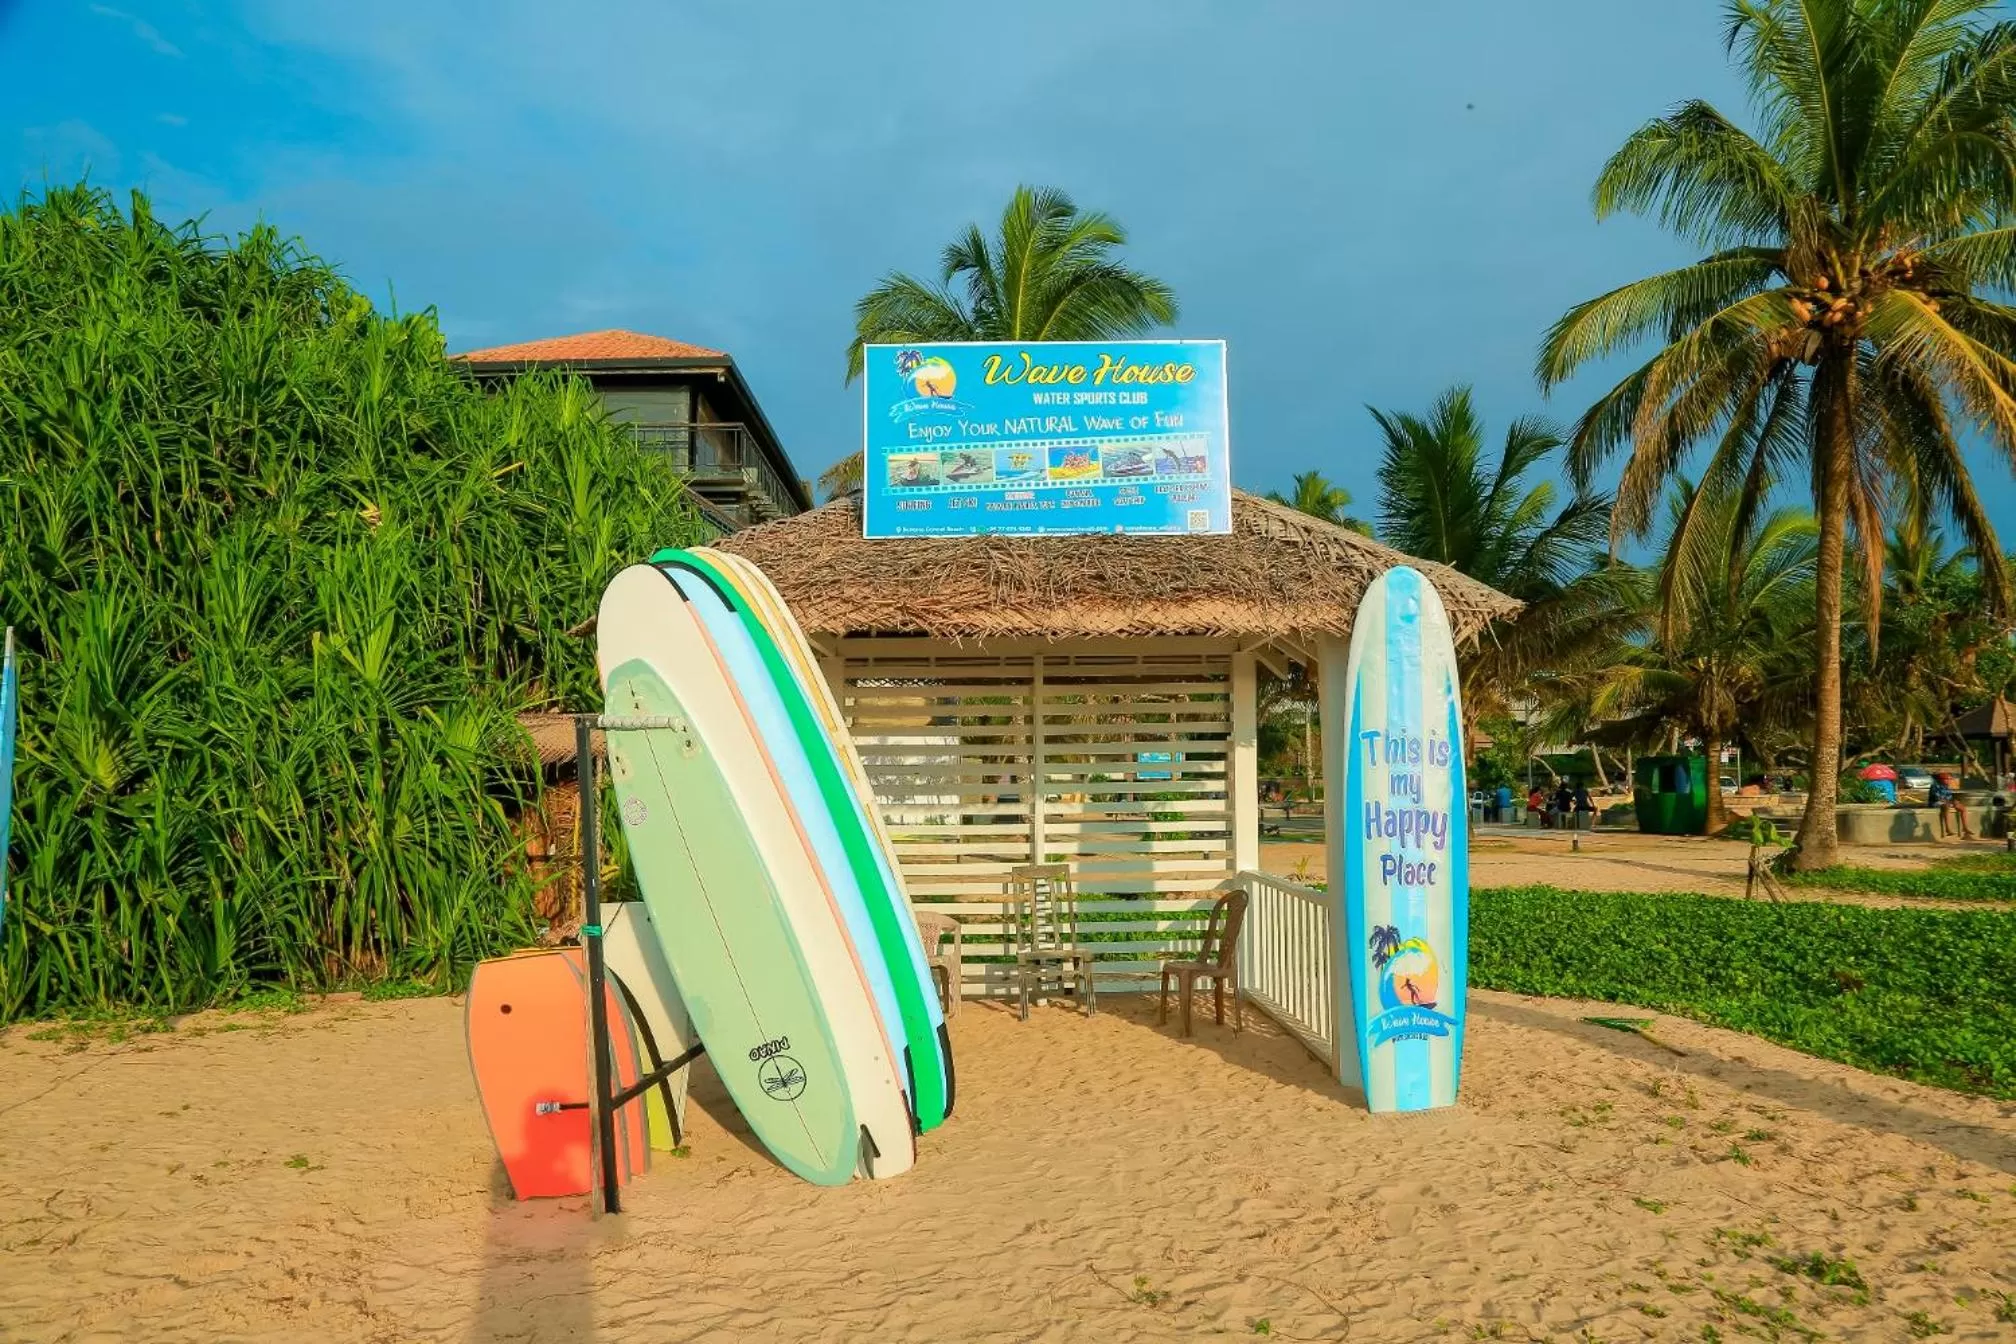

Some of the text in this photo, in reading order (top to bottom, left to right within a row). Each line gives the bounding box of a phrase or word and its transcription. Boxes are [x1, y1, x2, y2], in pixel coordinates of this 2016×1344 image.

[983, 352, 1197, 386] Wave House
[1033, 391, 1148, 405] WATER SPORTS CLUB
[1003, 415, 1078, 435] NATURAL
[1361, 728, 1450, 767] This is
[1390, 773, 1421, 805] my
[1364, 800, 1448, 851] Happy
[1379, 853, 1437, 886] Place
